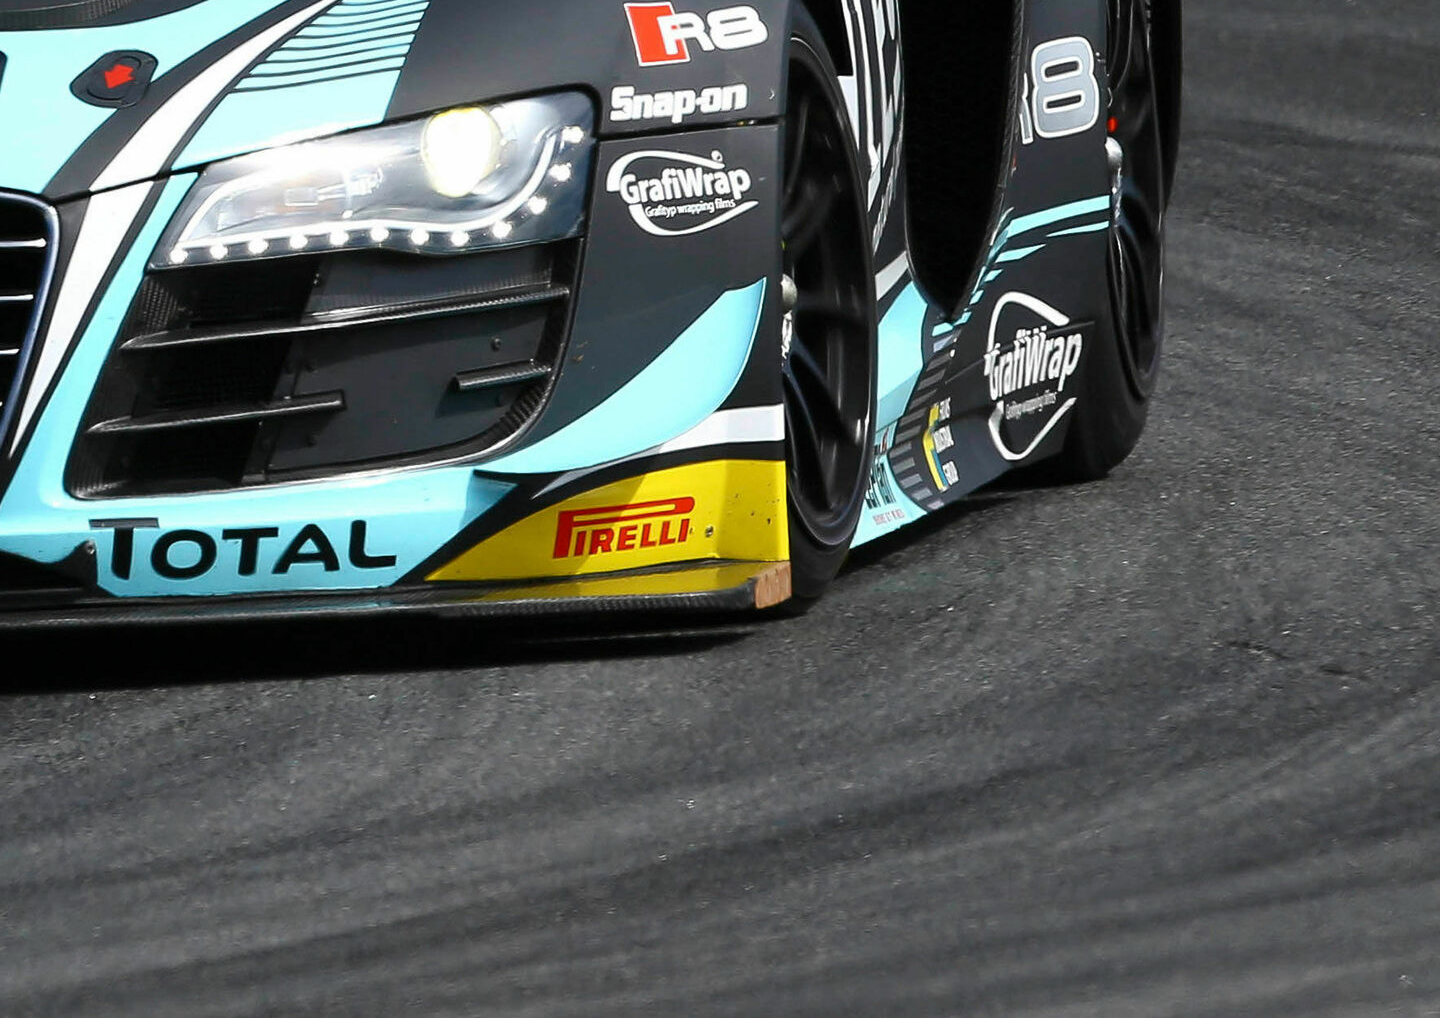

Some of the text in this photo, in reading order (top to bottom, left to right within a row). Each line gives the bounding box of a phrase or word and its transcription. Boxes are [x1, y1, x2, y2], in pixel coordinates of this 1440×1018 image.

[656, 5, 769, 56] R8
[609, 83, 749, 124] Snap-on
[619, 166, 752, 206] GrafiWrap
[715, 197, 737, 210] films
[984, 326, 1083, 401] GrafiWrap
[88, 517, 398, 581] TOTAL
[553, 495, 696, 562] PIRELLI
